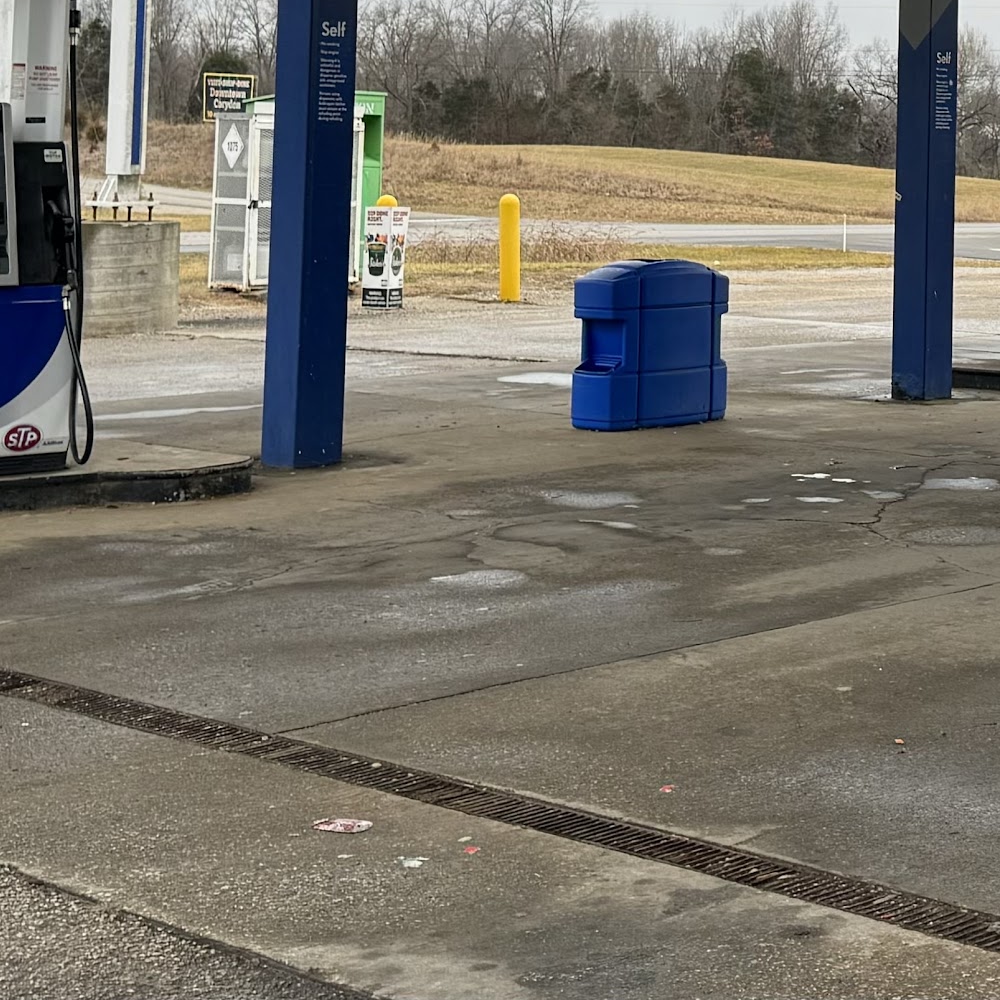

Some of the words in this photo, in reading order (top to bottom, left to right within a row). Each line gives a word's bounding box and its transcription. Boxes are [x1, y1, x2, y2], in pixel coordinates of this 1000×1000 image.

[322, 21, 346, 37] Self
[936, 52, 951, 64] Self
[209, 87, 246, 99] Downtown
[227, 142, 239, 152] 1075
[7, 428, 38, 448] STP
